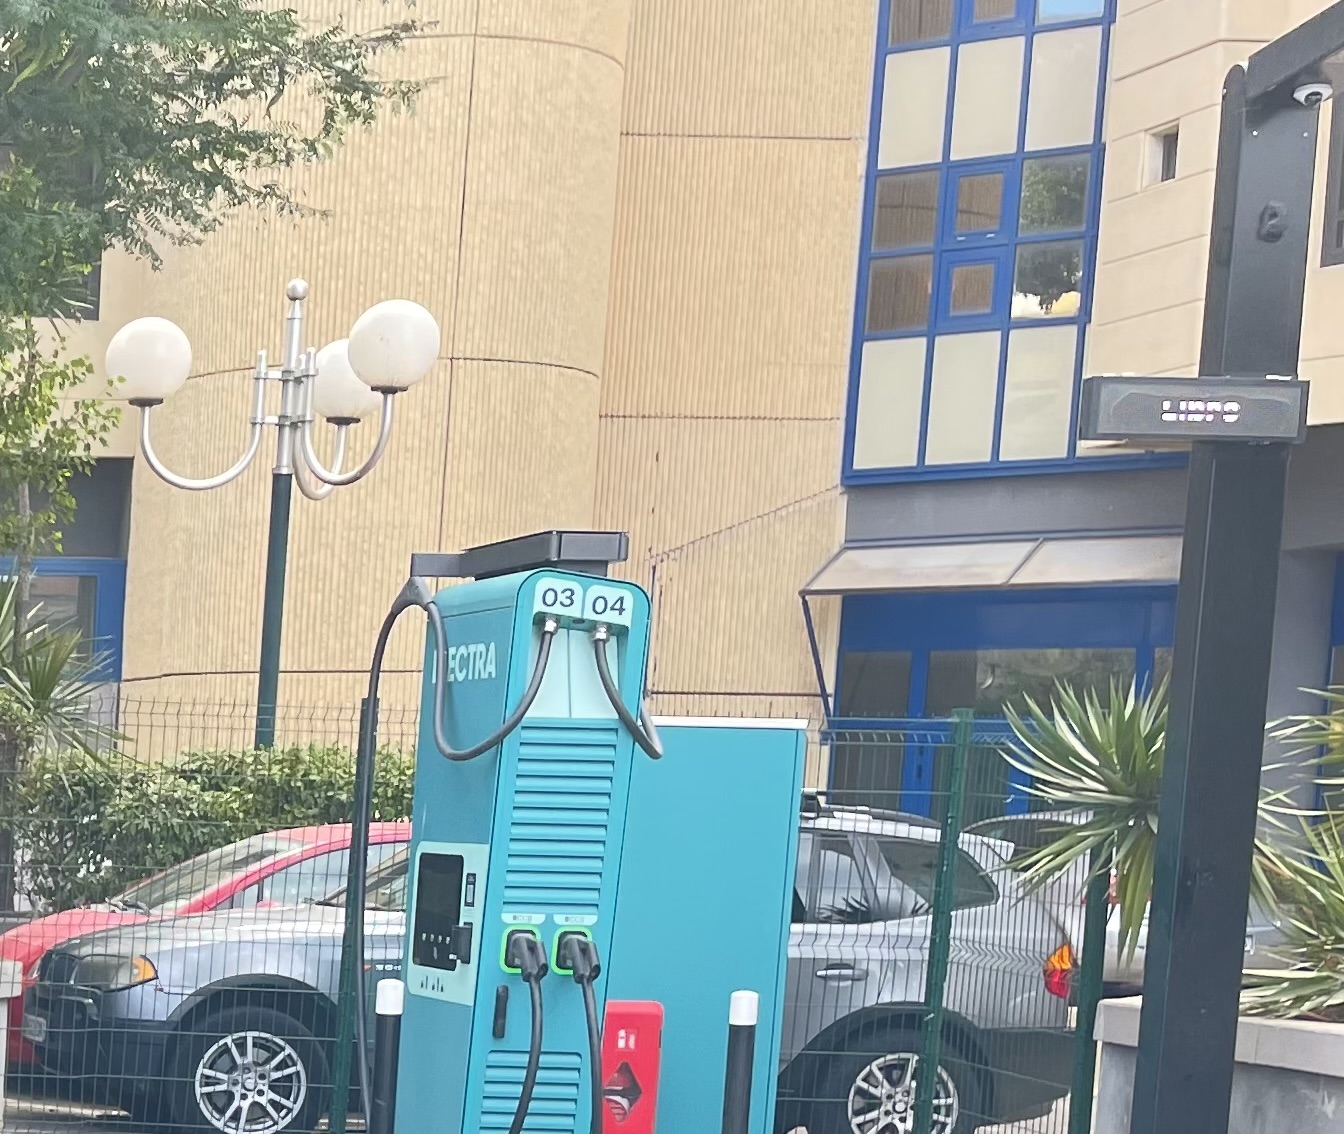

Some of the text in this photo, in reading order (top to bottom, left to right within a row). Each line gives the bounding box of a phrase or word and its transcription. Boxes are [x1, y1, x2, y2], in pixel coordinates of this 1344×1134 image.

[541, 587, 576, 607] 03
[592, 595, 626, 616] 04
[431, 641, 496, 684] ECTRA
